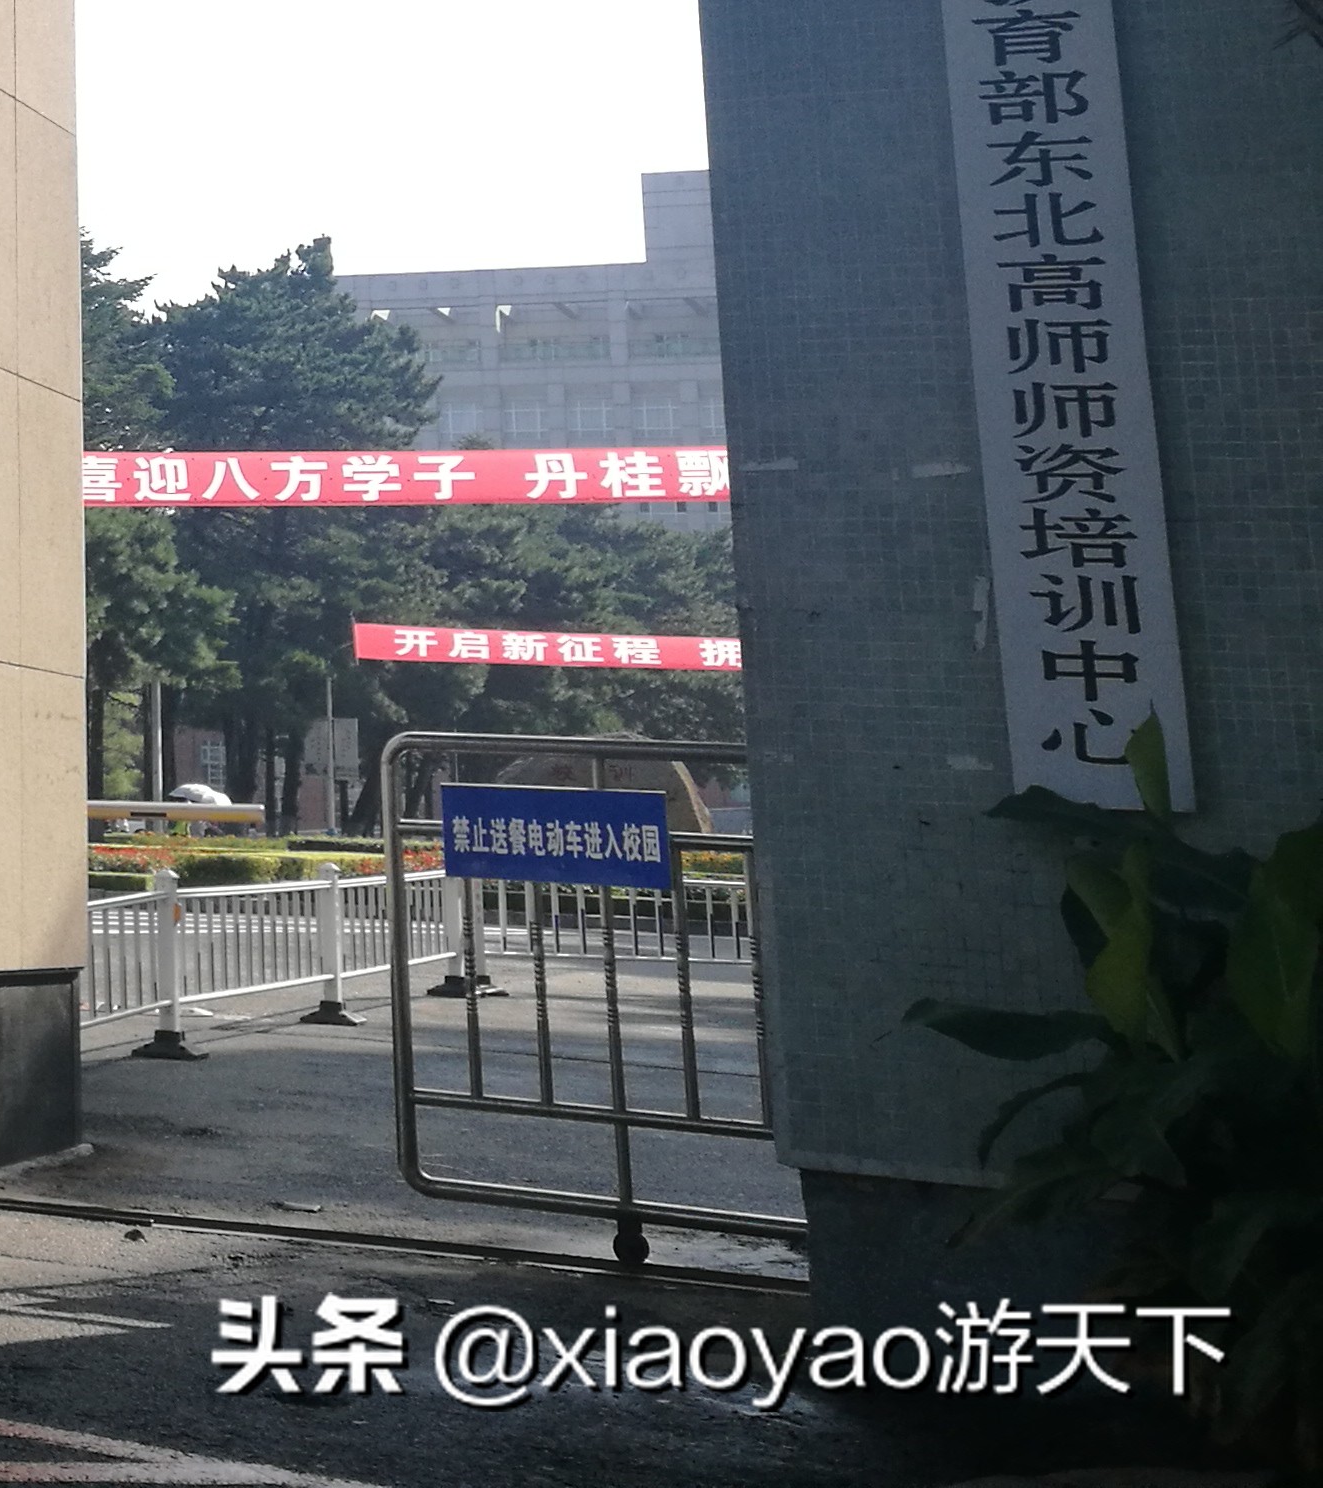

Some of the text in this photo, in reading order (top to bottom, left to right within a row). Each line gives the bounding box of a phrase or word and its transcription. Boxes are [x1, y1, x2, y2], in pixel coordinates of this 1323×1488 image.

[82, 449, 730, 502] 喜迎八方学子 丹桂飘
[394, 629, 662, 665] 开启新征程
[453, 815, 662, 863] 禁止送餐电动车进入校园
